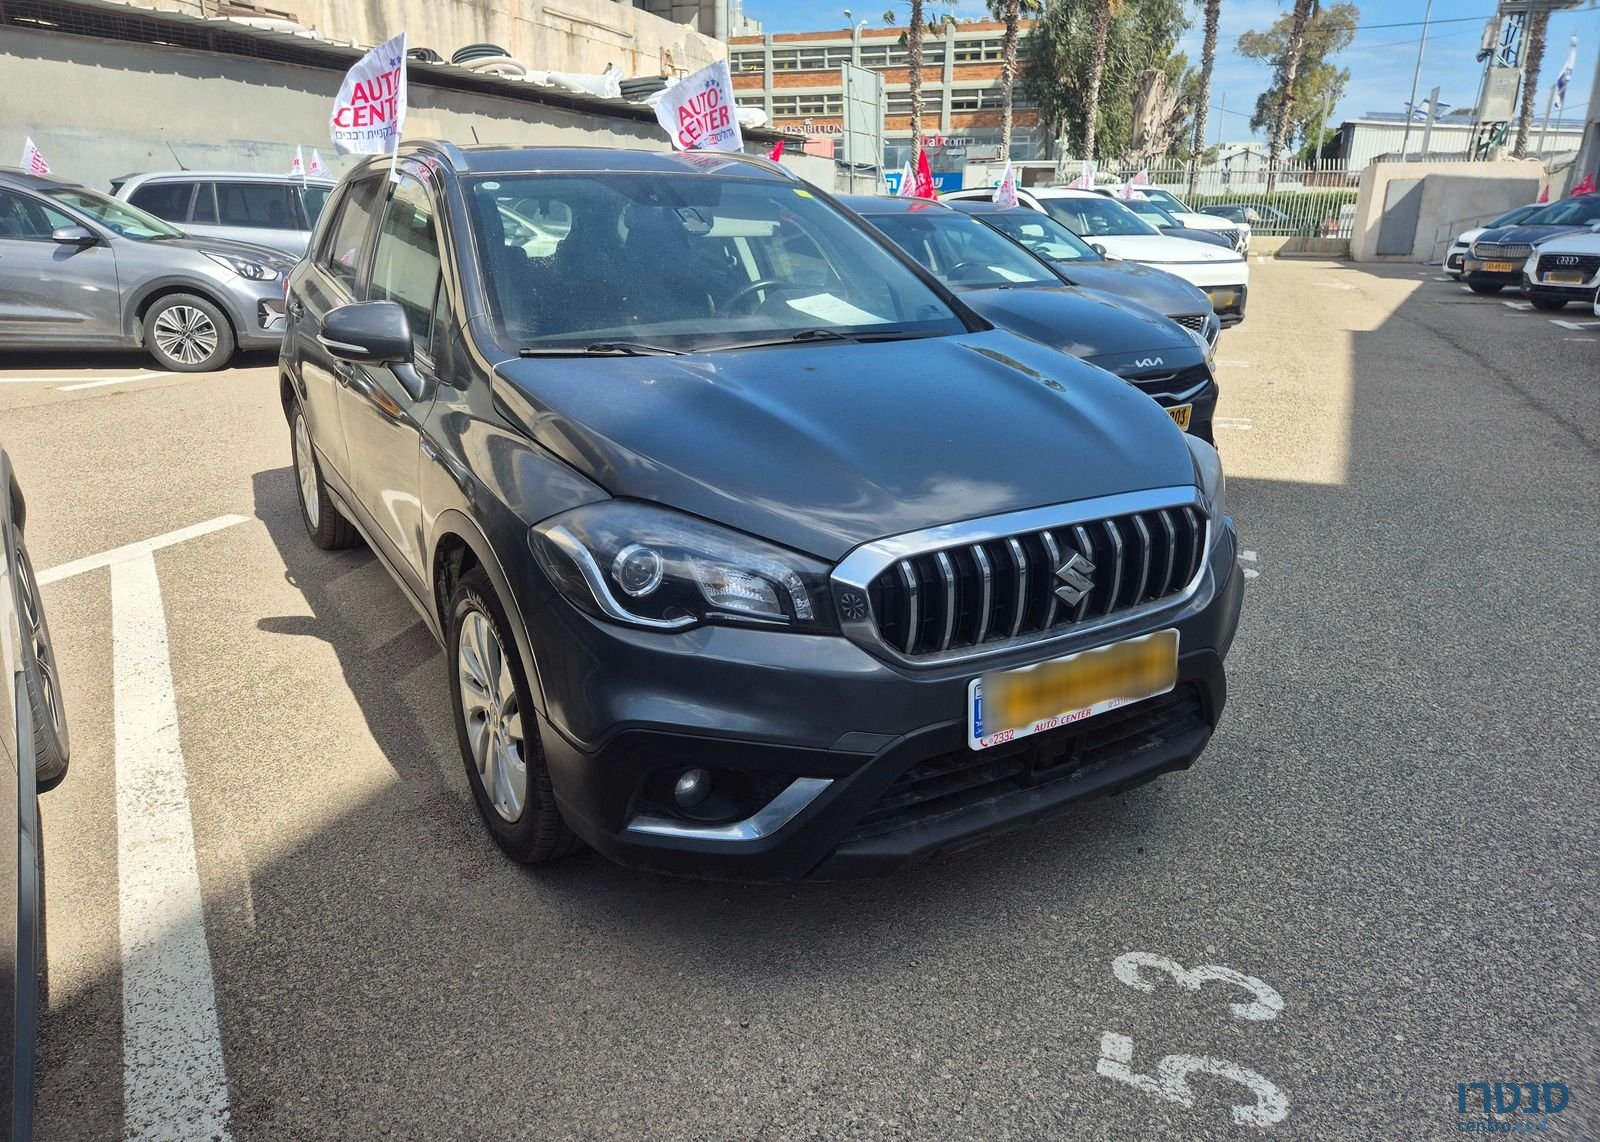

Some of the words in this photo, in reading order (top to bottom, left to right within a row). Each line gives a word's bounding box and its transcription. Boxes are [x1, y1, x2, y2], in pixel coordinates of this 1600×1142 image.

[678, 87, 719, 127] AUTO
[335, 130, 365, 140] רכבים
[367, 125, 393, 140] בקניית
[677, 105, 730, 148] CENTER
[1033, 719, 1057, 733] AUTO
[1060, 708, 1093, 725] CENTER
